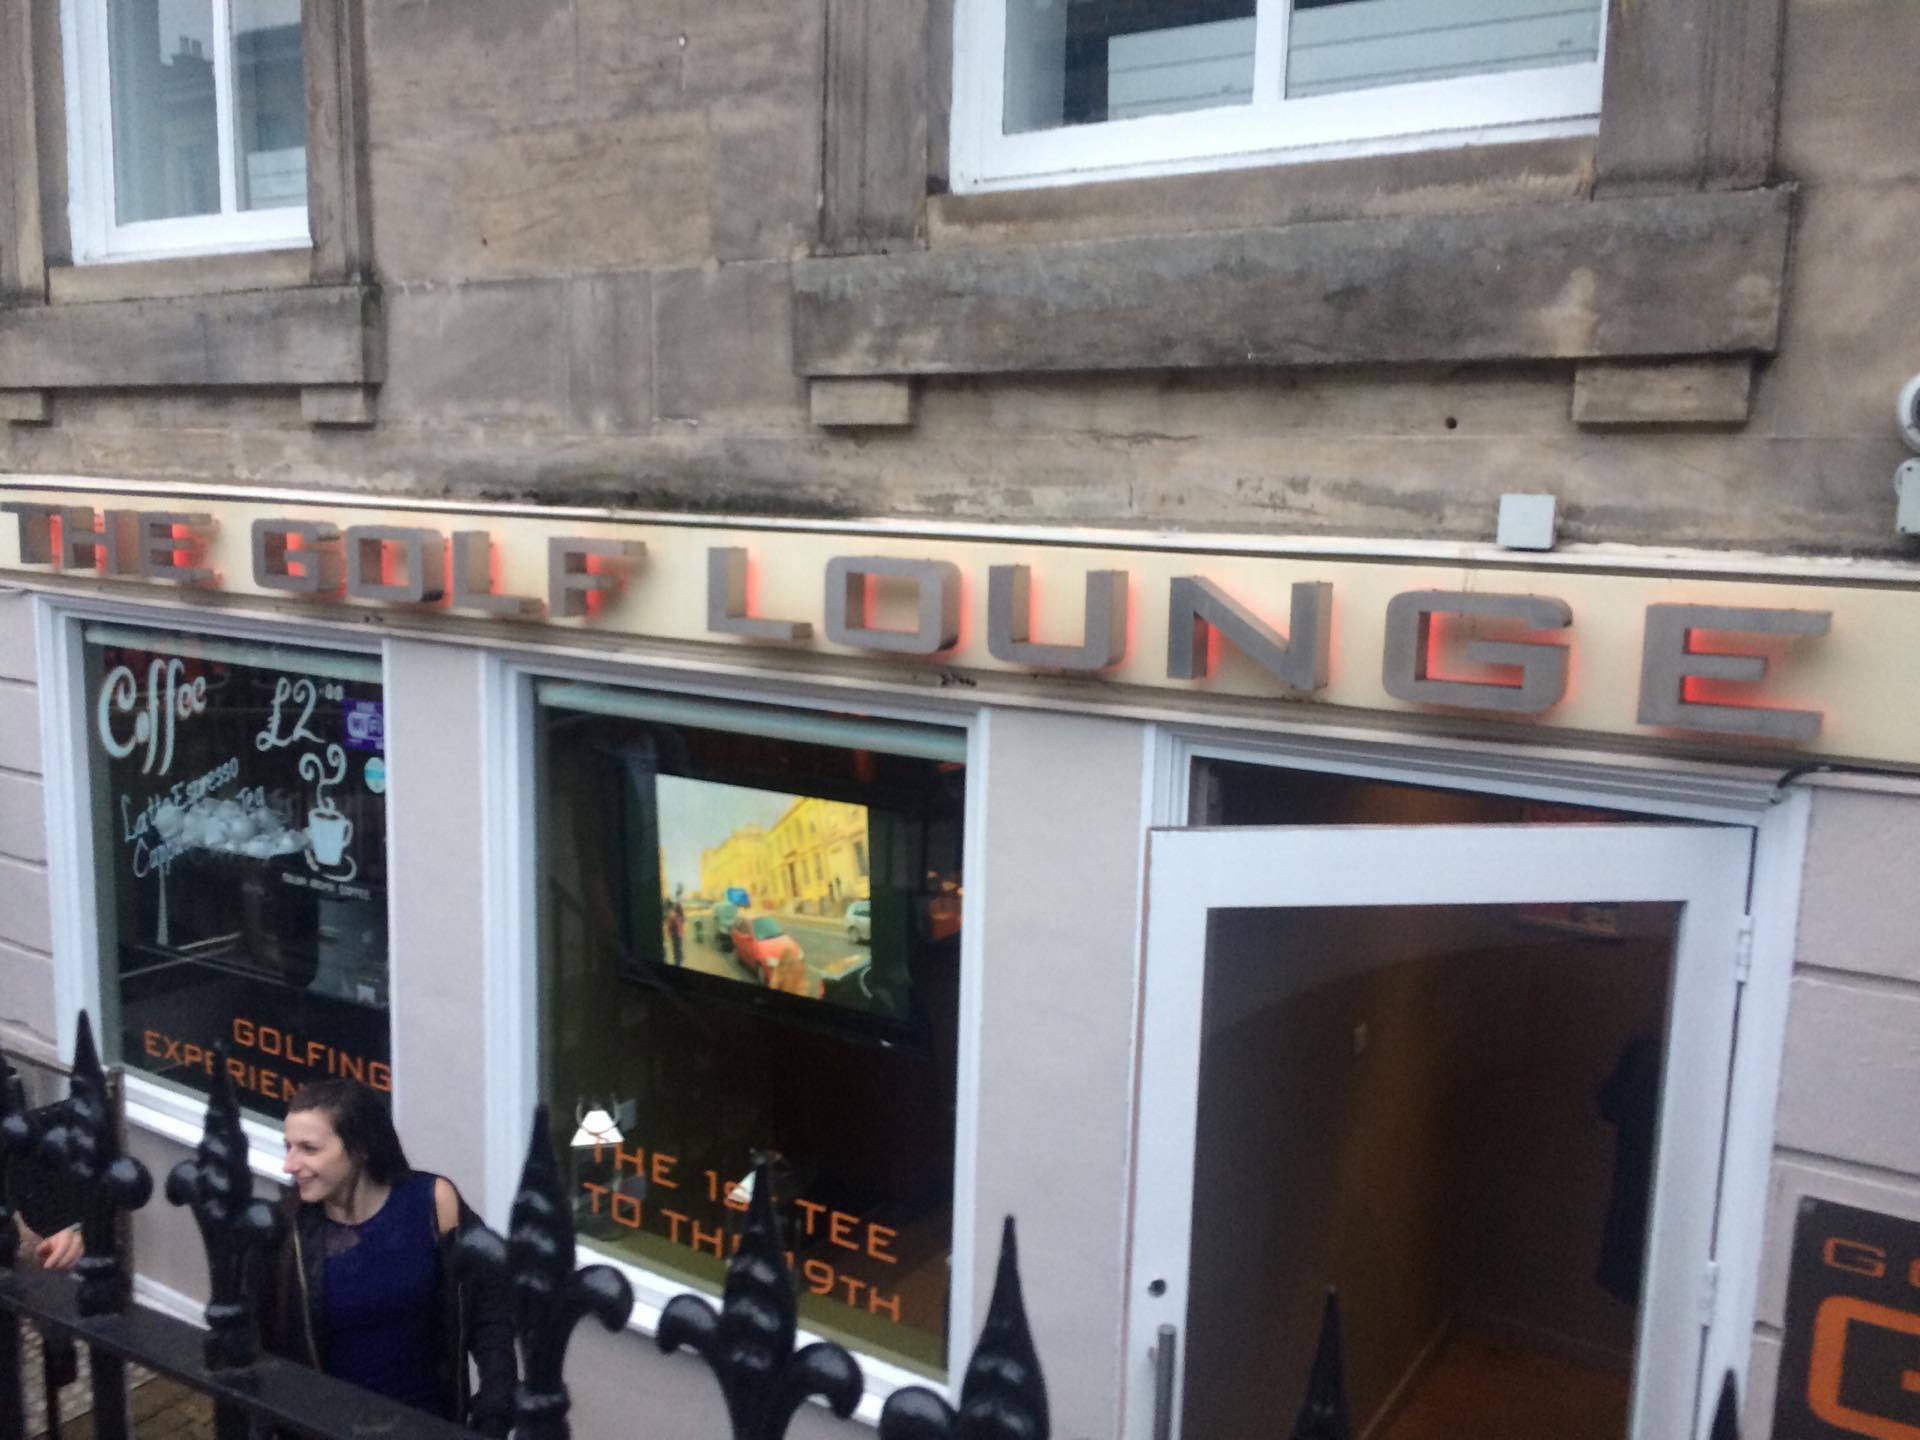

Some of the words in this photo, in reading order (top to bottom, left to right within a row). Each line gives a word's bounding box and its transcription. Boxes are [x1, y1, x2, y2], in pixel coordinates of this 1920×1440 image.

[1, 501, 215, 581] THE
[251, 517, 648, 618] GOLF
[706, 546, 1833, 742] LOUNGE
[98, 658, 207, 776] Coffee
[143, 1030, 304, 1101] EXPERIEN
[232, 1017, 392, 1092] GOLFING
[583, 1181, 642, 1229] TO
[588, 1136, 679, 1189] THE
[795, 1198, 898, 1264] TEE
